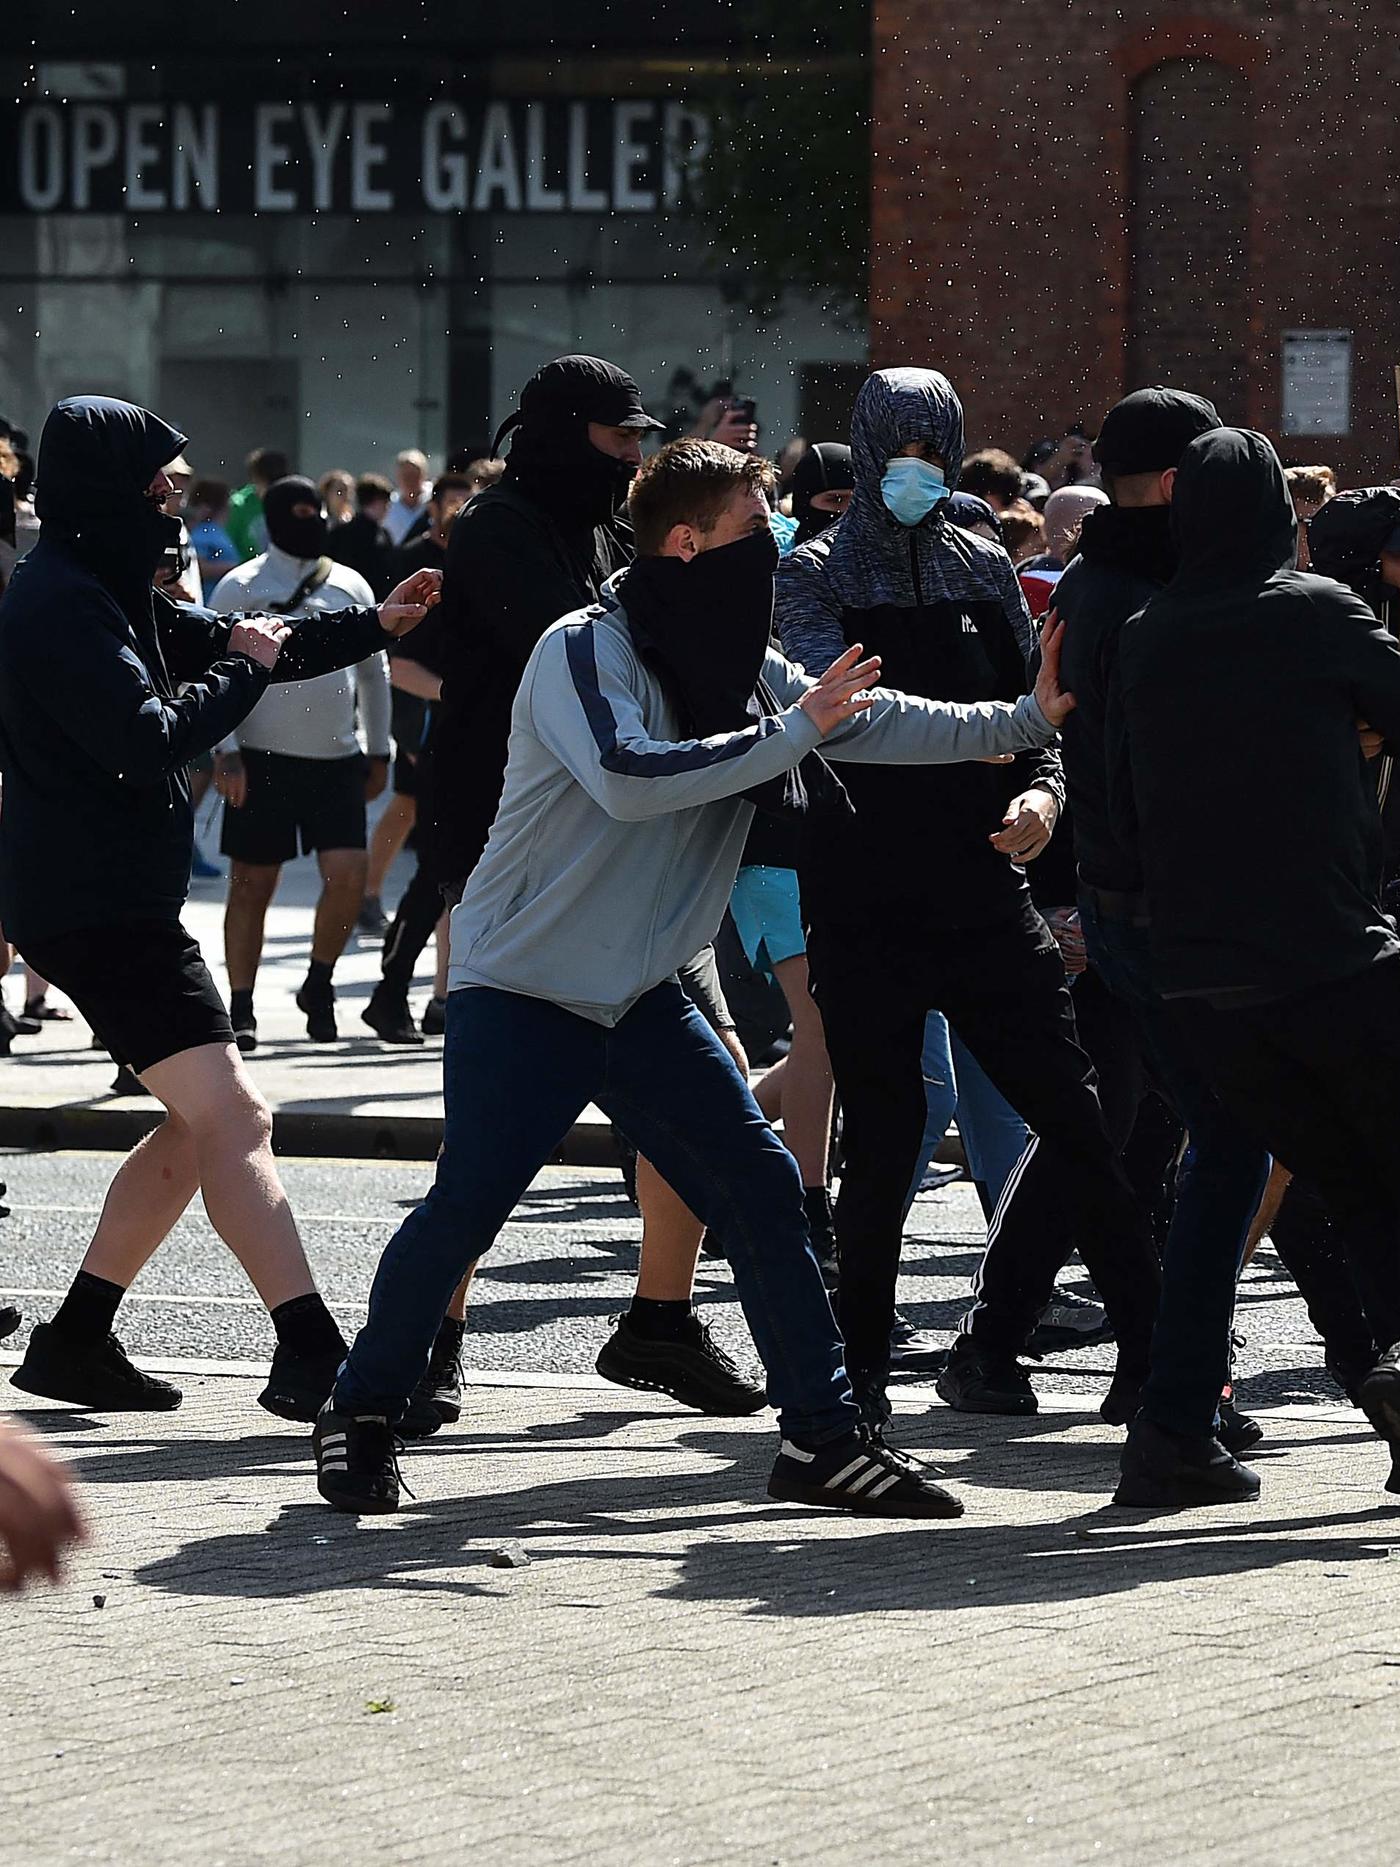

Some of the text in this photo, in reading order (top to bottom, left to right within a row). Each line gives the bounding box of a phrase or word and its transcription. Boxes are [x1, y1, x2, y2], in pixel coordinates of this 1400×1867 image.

[18, 101, 712, 212] OPEN EYE GALLER
